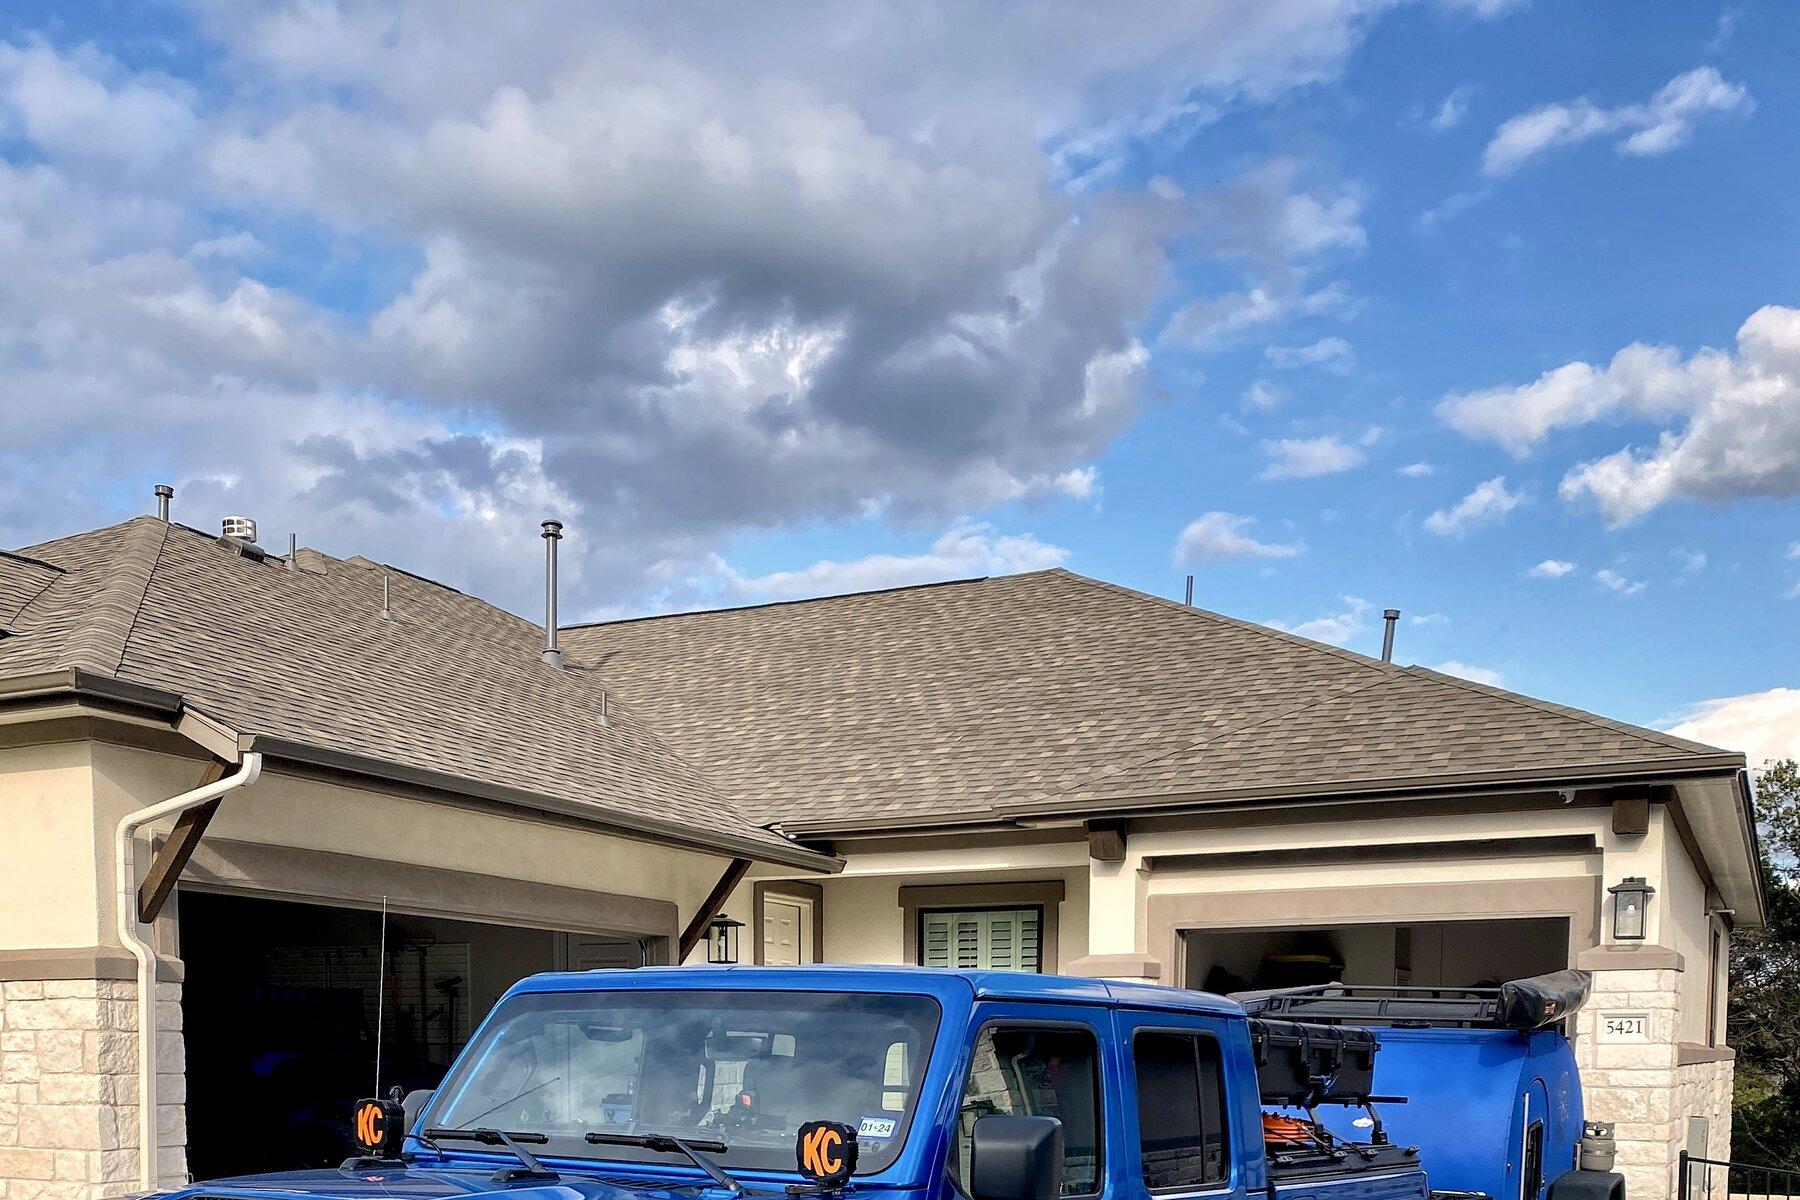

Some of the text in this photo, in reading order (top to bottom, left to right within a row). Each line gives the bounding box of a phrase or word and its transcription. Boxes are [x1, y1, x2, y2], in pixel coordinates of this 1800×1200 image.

[1606, 1020, 1643, 1035] 5421
[357, 1103, 384, 1147] KC
[803, 1126, 842, 1177] KC
